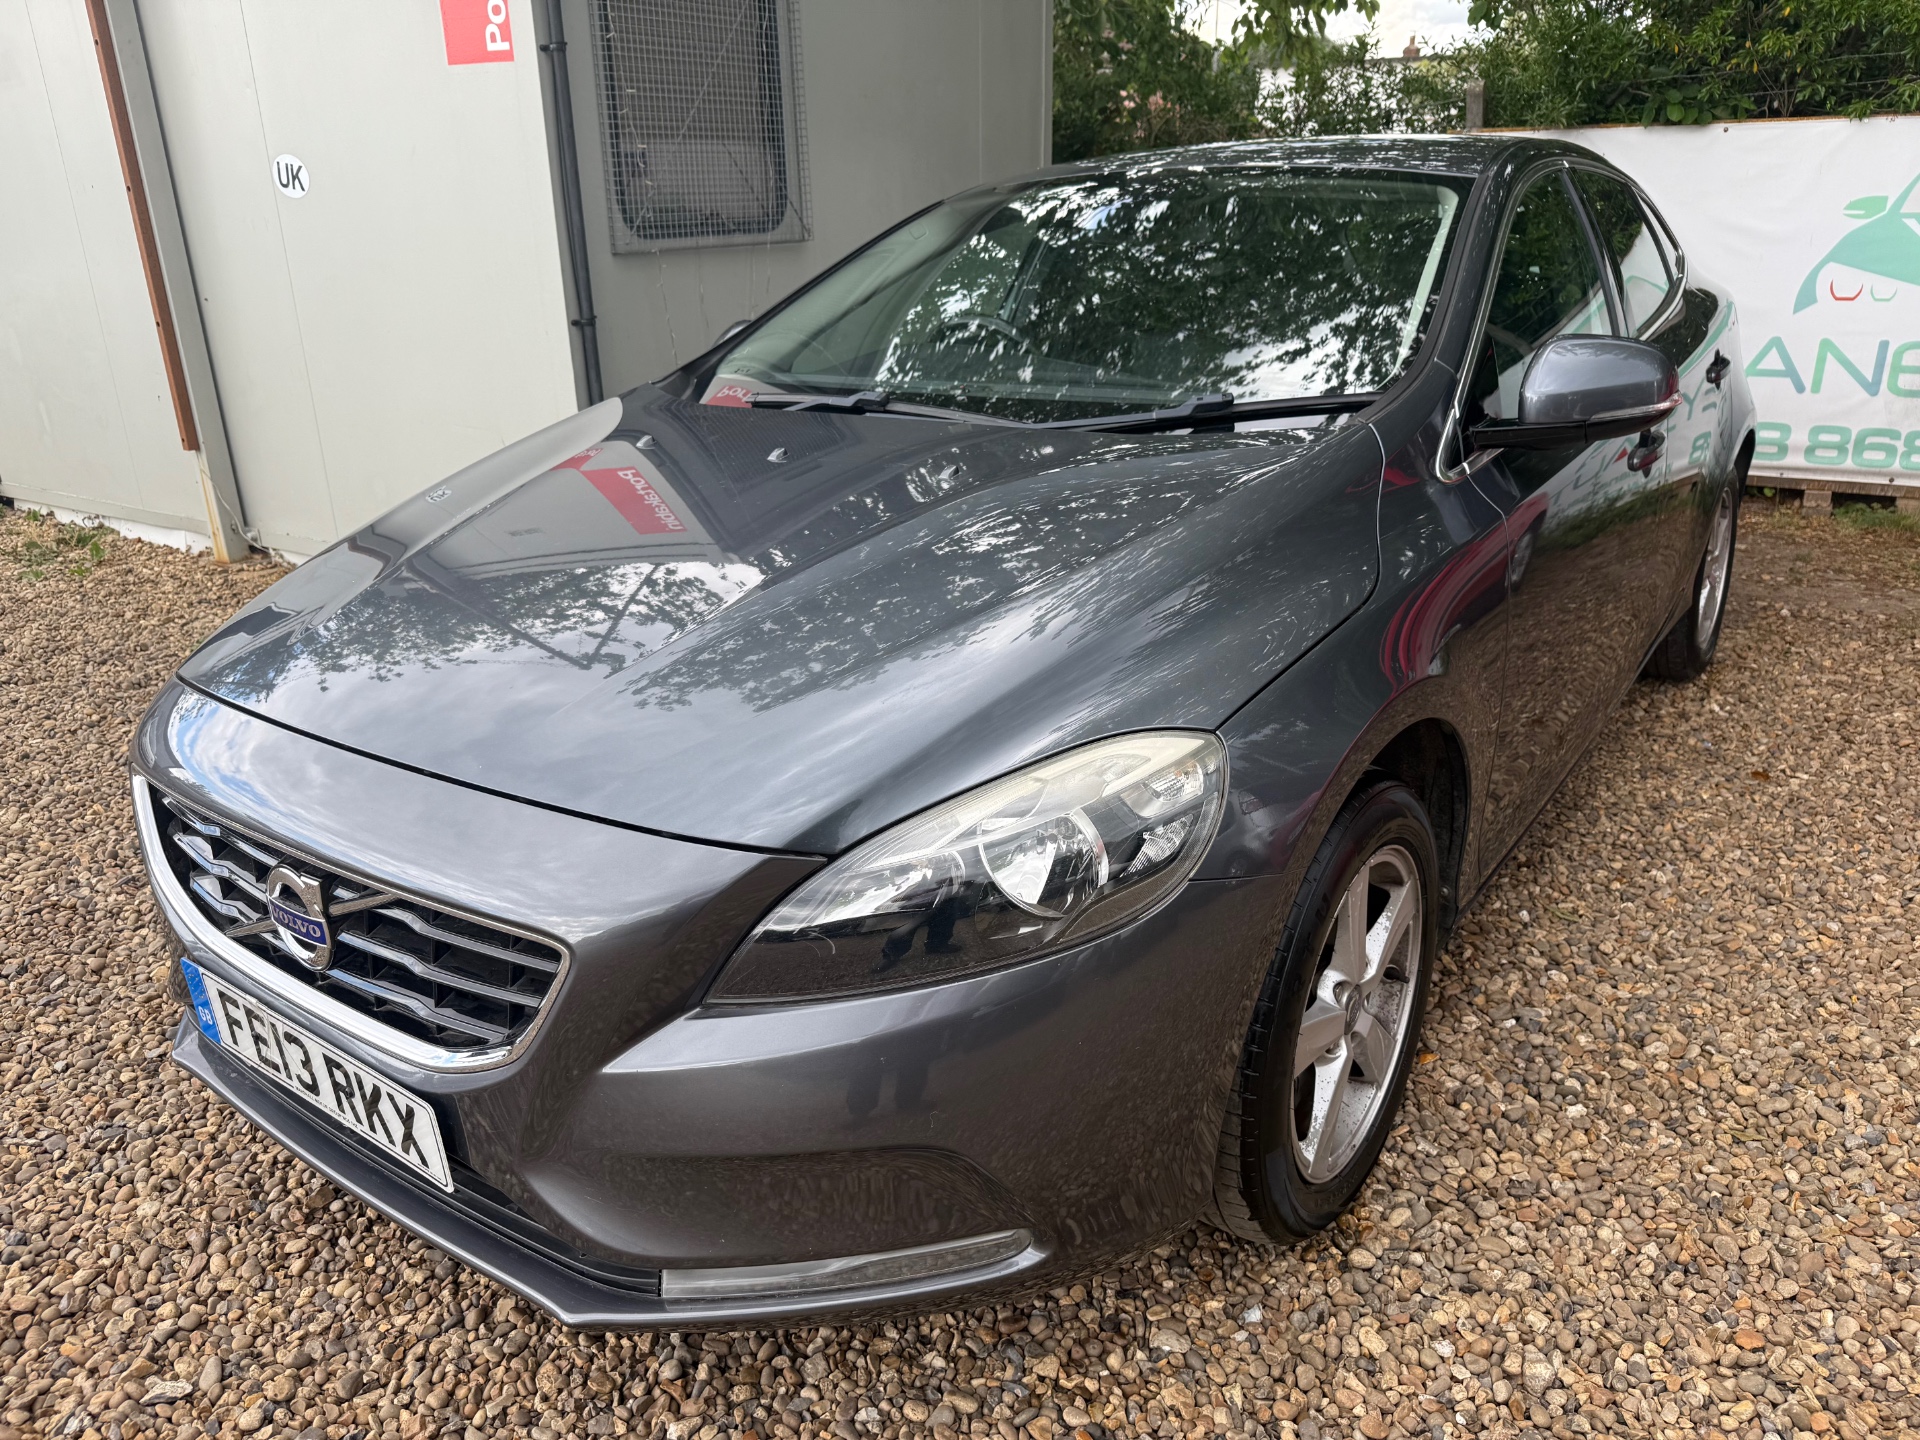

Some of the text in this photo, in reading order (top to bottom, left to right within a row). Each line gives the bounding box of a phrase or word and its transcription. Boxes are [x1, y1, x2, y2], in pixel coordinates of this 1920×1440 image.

[276, 161, 306, 192] UK
[271, 905, 321, 938] VOLVO
[199, 1006, 214, 1026] GB
[217, 987, 431, 1170] FE13 RKX
